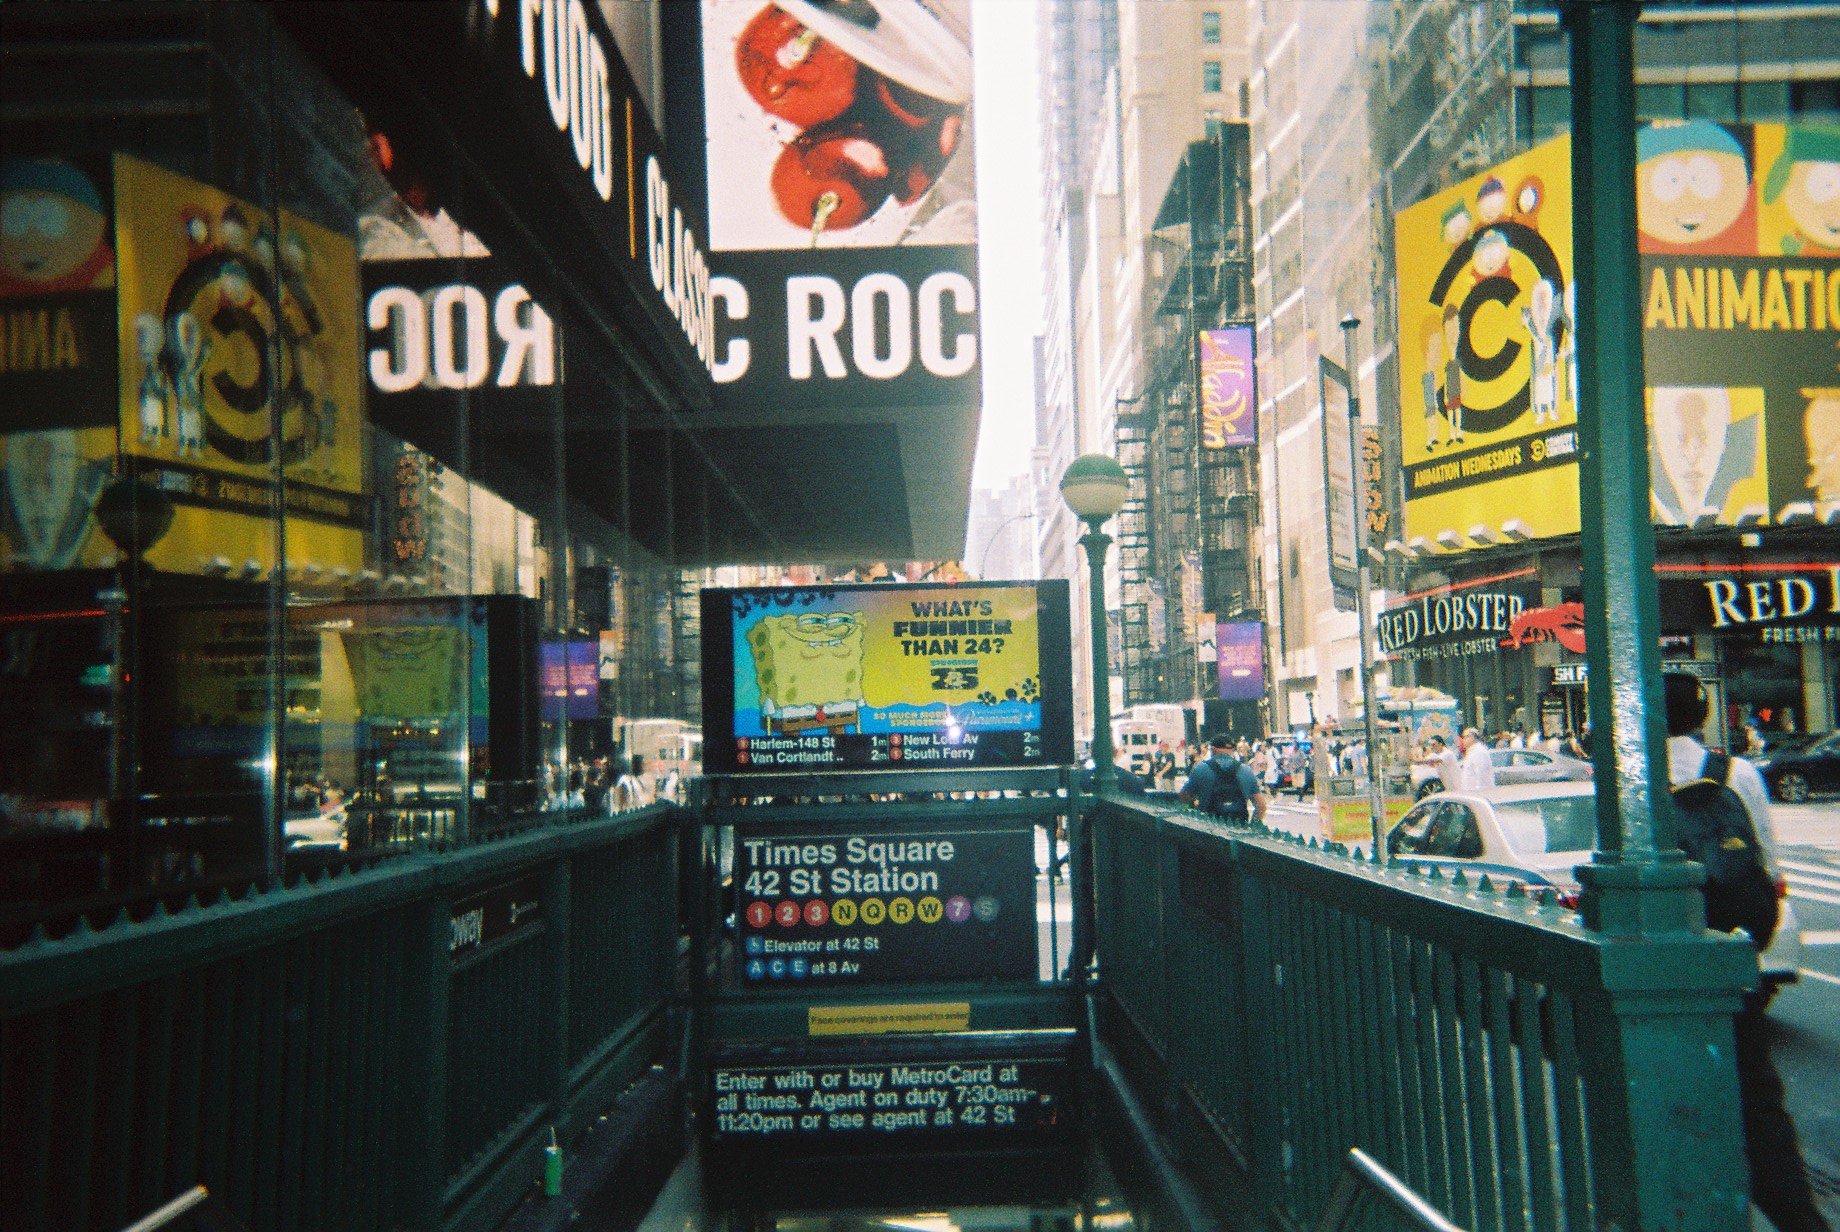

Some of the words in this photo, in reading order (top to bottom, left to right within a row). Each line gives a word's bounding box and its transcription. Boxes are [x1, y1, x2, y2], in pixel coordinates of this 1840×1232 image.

[786, 271, 977, 380] ROC
[911, 600, 993, 618] WHAT'S
[1703, 578, 1817, 628] RED
[893, 619, 1013, 637] FUNNIER
[1379, 609, 1419, 653] RED
[1762, 626, 1820, 643] FRESH
[901, 639, 959, 656] THAN
[965, 637, 1005, 654] 24?
[1461, 637, 1497, 656] LOBSTER
[750, 737, 819, 750] Harlem-148
[822, 736, 836, 748] St
[903, 735, 930, 746] New
[963, 733, 979, 744] Av
[751, 752, 774, 763] Van
[776, 750, 834, 763] Cortlandt
[904, 748, 940, 760] South
[943, 747, 976, 761] Ferry
[744, 840, 838, 866] Times
[846, 837, 955, 869] Square
[744, 870, 780, 896] 42
[789, 868, 822, 895] St
[831, 866, 939, 894] Station
[764, 939, 823, 952] Elevator
[826, 939, 840, 951] at
[843, 937, 860, 950] 42
[863, 936, 880, 950] St
[811, 962, 825, 974] at
[828, 961, 837, 974] 8
[841, 960, 860, 973] Av
[716, 1072, 767, 1090] Enter
[774, 1071, 814, 1088] with
[820, 1073, 842, 1088] or
[849, 1068, 884, 1088] buy
[891, 1065, 993, 1085] MetroCard
[999, 1065, 1019, 1083] at
[716, 1092, 738, 1111] all
[744, 1092, 802, 1109] times.
[809, 1090, 867, 1111] Agent
[873, 1091, 899, 1107] on
[905, 1088, 949, 1108] duty
[718, 1112, 794, 1134] 11:20pm
[800, 1114, 822, 1130] or
[828, 1113, 865, 1129] see
[871, 1109, 928, 1131] agent
[934, 1107, 953, 1126] at
[960, 1105, 987, 1125] 42
[993, 1104, 1016, 1124] St
